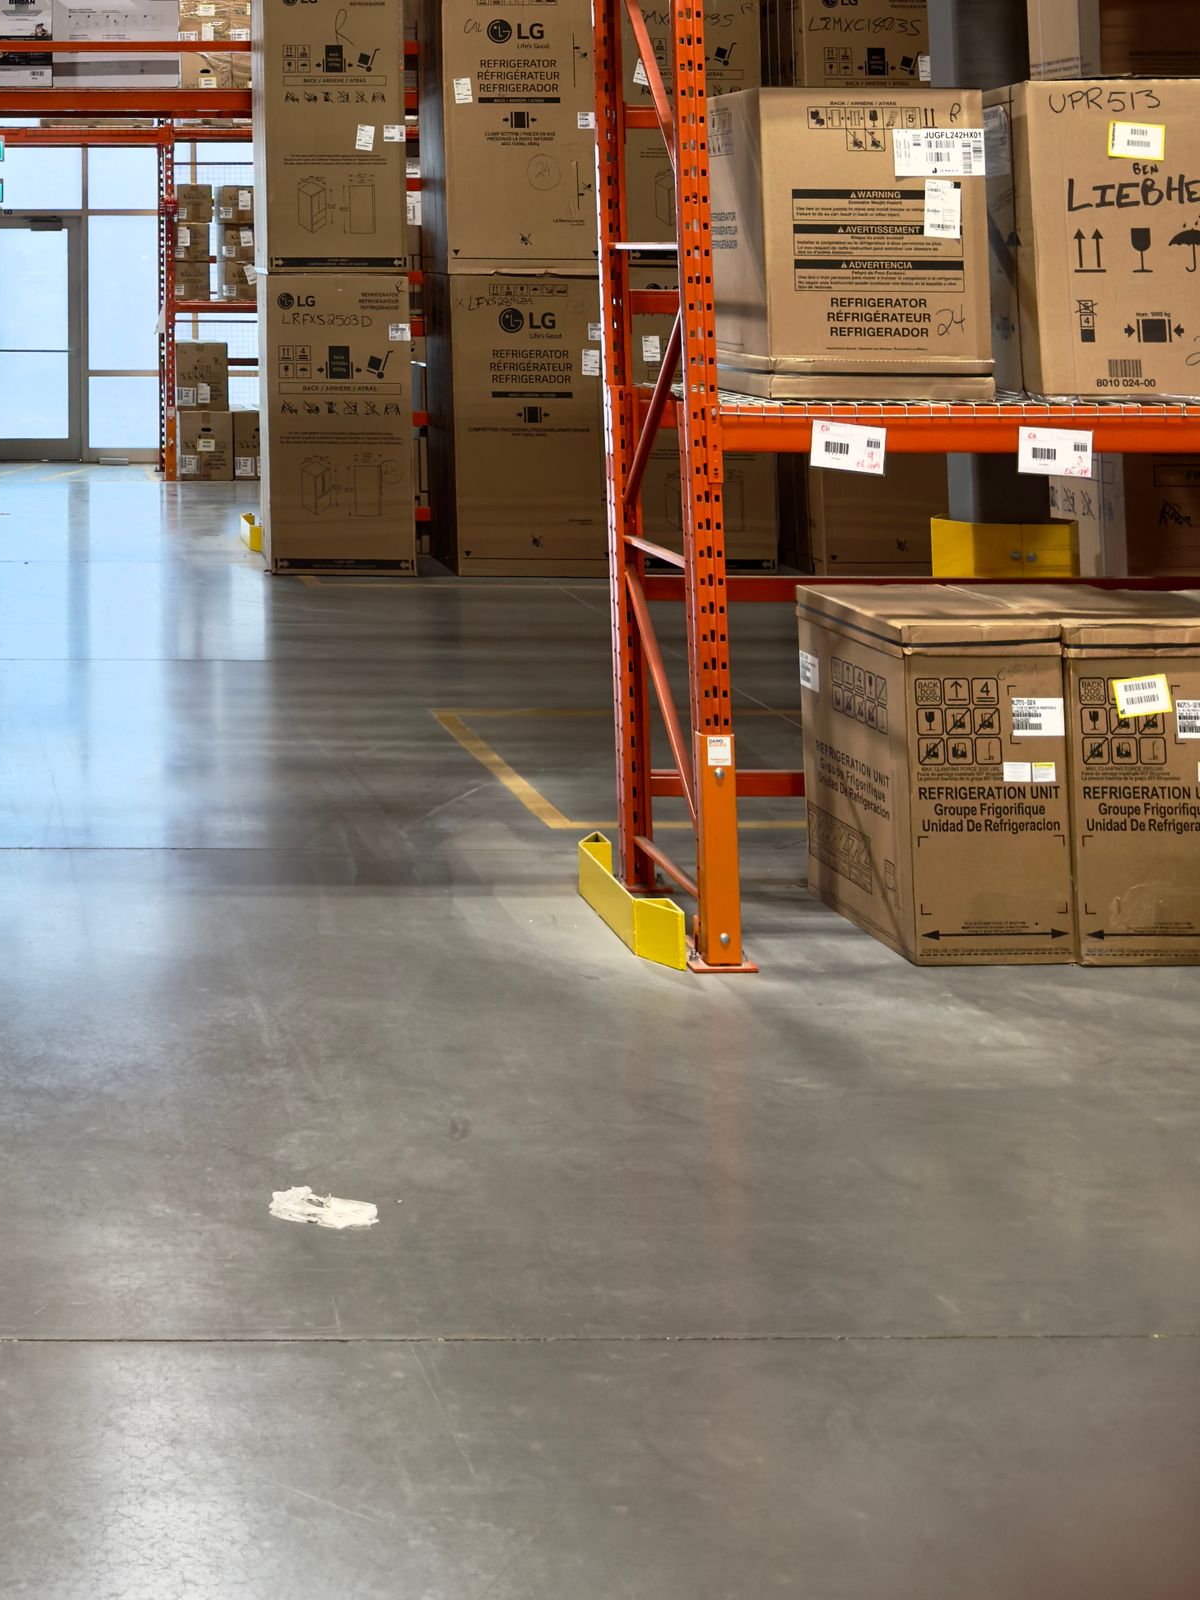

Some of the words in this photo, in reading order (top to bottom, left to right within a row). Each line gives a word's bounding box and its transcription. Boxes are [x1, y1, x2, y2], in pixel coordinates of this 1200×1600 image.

[517, 23, 544, 40] LG
[480, 59, 557, 68] REFRIGERATOR
[477, 69, 560, 80] RÉFRIGÉRATEUR
[479, 84, 558, 93] REFRIGERADOR
[924, 131, 982, 139] JUGFL242HX01
[1132, 162, 1159, 175] BEN
[857, 191, 901, 199] WARNING
[1067, 174, 1200, 212] LIEBHE
[846, 226, 921, 234] AVERTISSEMENT
[849, 261, 913, 269] ADVERTENCIA
[297, 296, 316, 307] LG
[830, 297, 927, 308] REFRIGERATOR
[529, 312, 556, 329] LG
[827, 309, 931, 323] RÉFRIGÉRATEUR
[936, 304, 966, 336] 24
[830, 327, 929, 338] REFRIGERADOR
[492, 350, 569, 359] REFRIGERATOR
[490, 360, 573, 372] RÉFRIGÉRATEUR
[492, 375, 571, 383] REFRIGERADOR
[1096, 379, 1120, 387] 8010
[1122, 379, 1156, 387] 024-00
[816, 740, 871, 778] REFRIGERATION
[918, 786, 1026, 800] REFRIGERATION
[1030, 786, 1060, 799] UNIT
[1083, 786, 1190, 800] REFRIGERATION
[934, 804, 977, 818] Groupe
[980, 803, 1045, 818] Frigorifique
[1098, 803, 1141, 817] Groupe
[922, 820, 963, 832] Unidad
[967, 820, 982, 832] De
[984, 818, 1060, 834] Refrigeracion
[1086, 819, 1127, 832] Unidad
[1130, 819, 1146, 831] De
